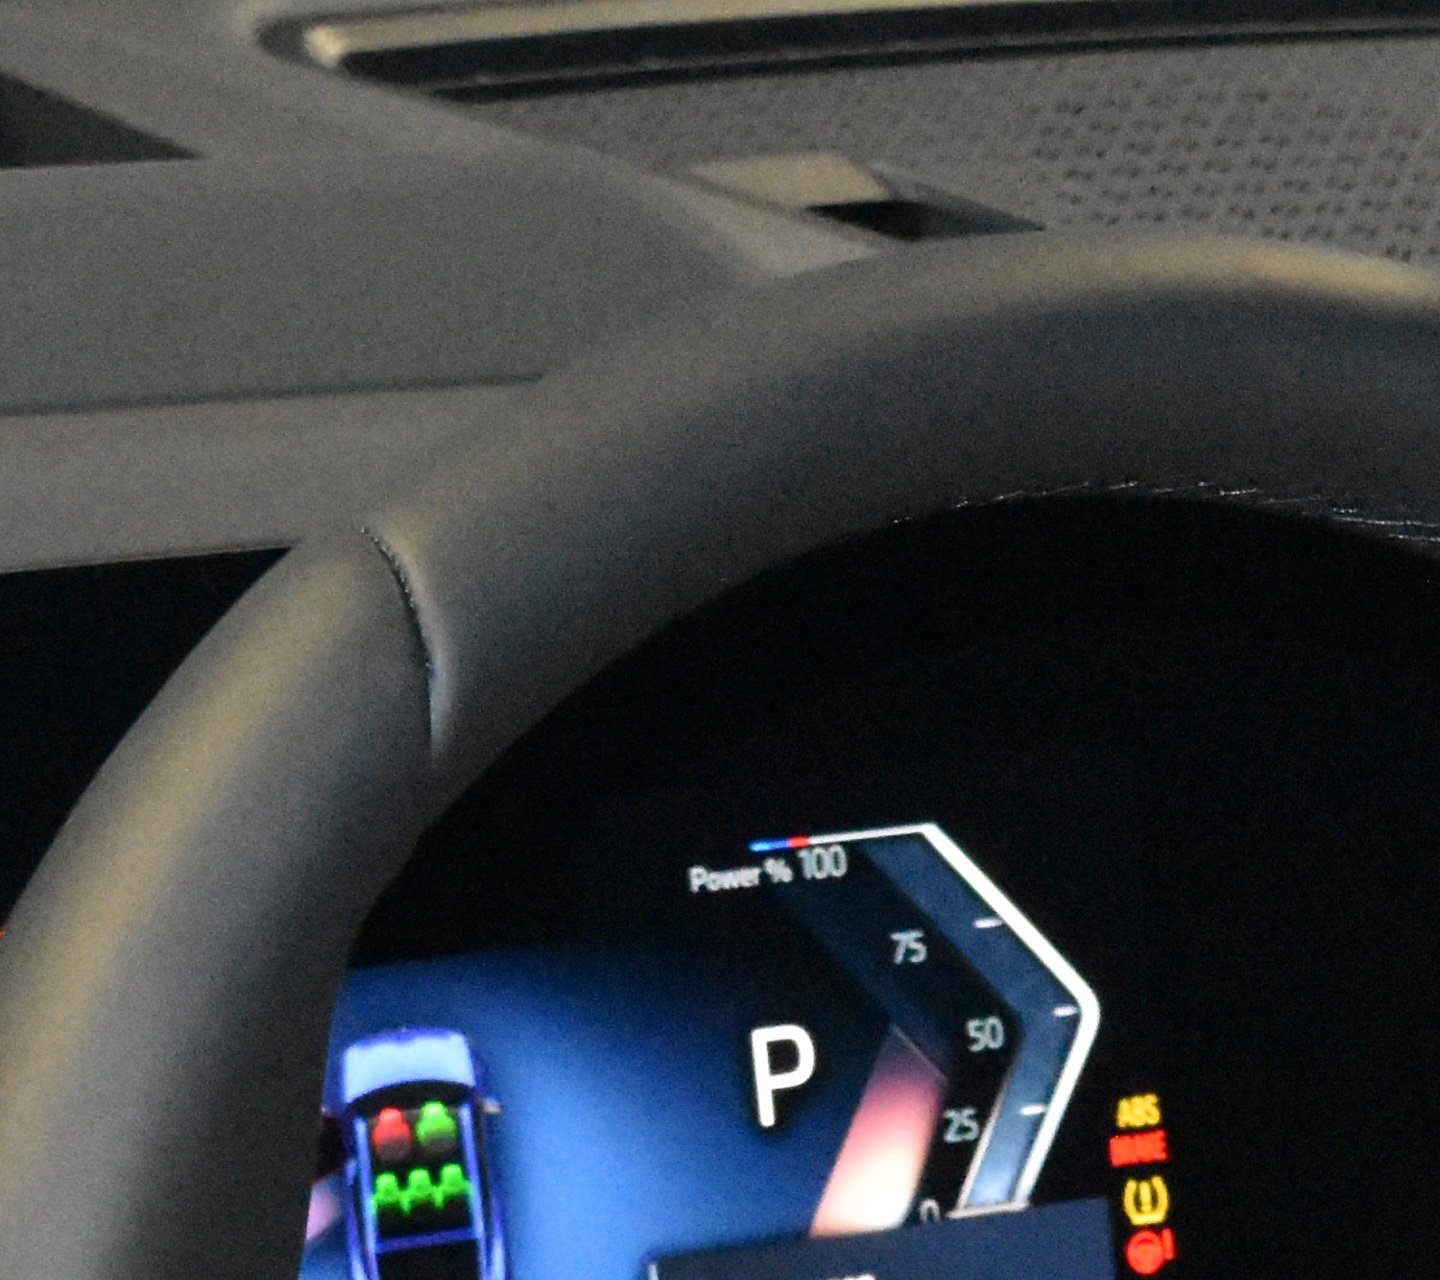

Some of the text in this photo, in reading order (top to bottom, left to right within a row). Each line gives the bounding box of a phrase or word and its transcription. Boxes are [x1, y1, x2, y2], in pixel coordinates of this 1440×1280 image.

[687, 863, 761, 893] Power
[796, 844, 849, 880] 100
[888, 928, 928, 966] 75
[965, 1014, 1006, 1054] 50
[749, 1022, 816, 1128] P
[942, 1106, 980, 1144] 25
